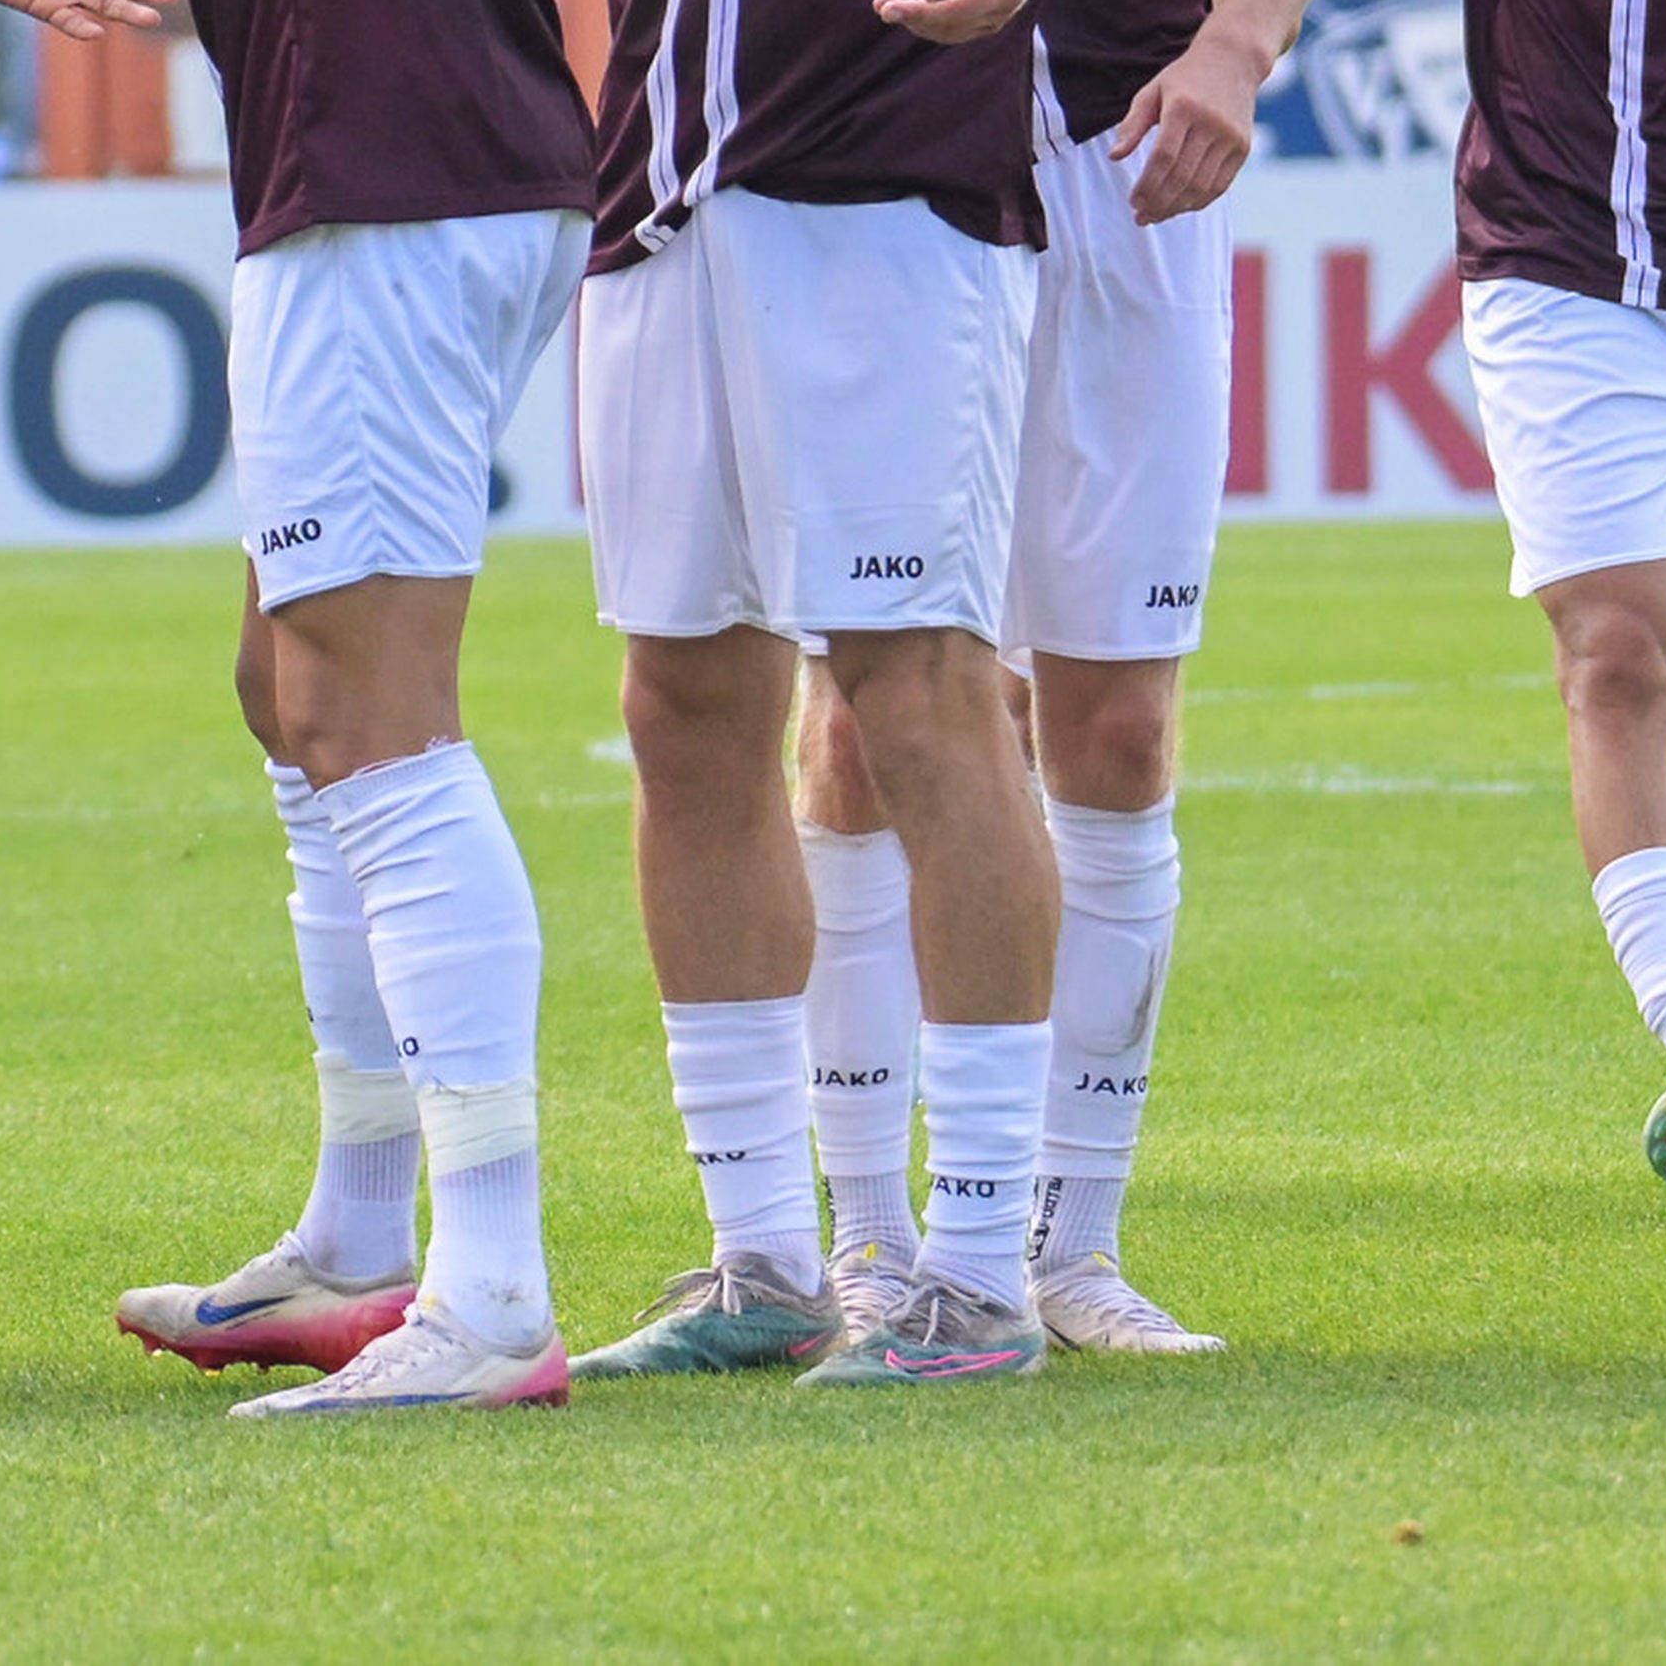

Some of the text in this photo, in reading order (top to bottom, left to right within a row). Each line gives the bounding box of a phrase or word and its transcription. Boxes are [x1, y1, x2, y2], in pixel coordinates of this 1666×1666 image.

[260, 518, 322, 556] JAKO
[850, 555, 924, 580] JAKO
[1144, 583, 1201, 611] JAKO
[812, 1065, 890, 1088] JAKO
[1074, 1072, 1149, 1096] JAKO
[931, 1176, 996, 1200] AKO
